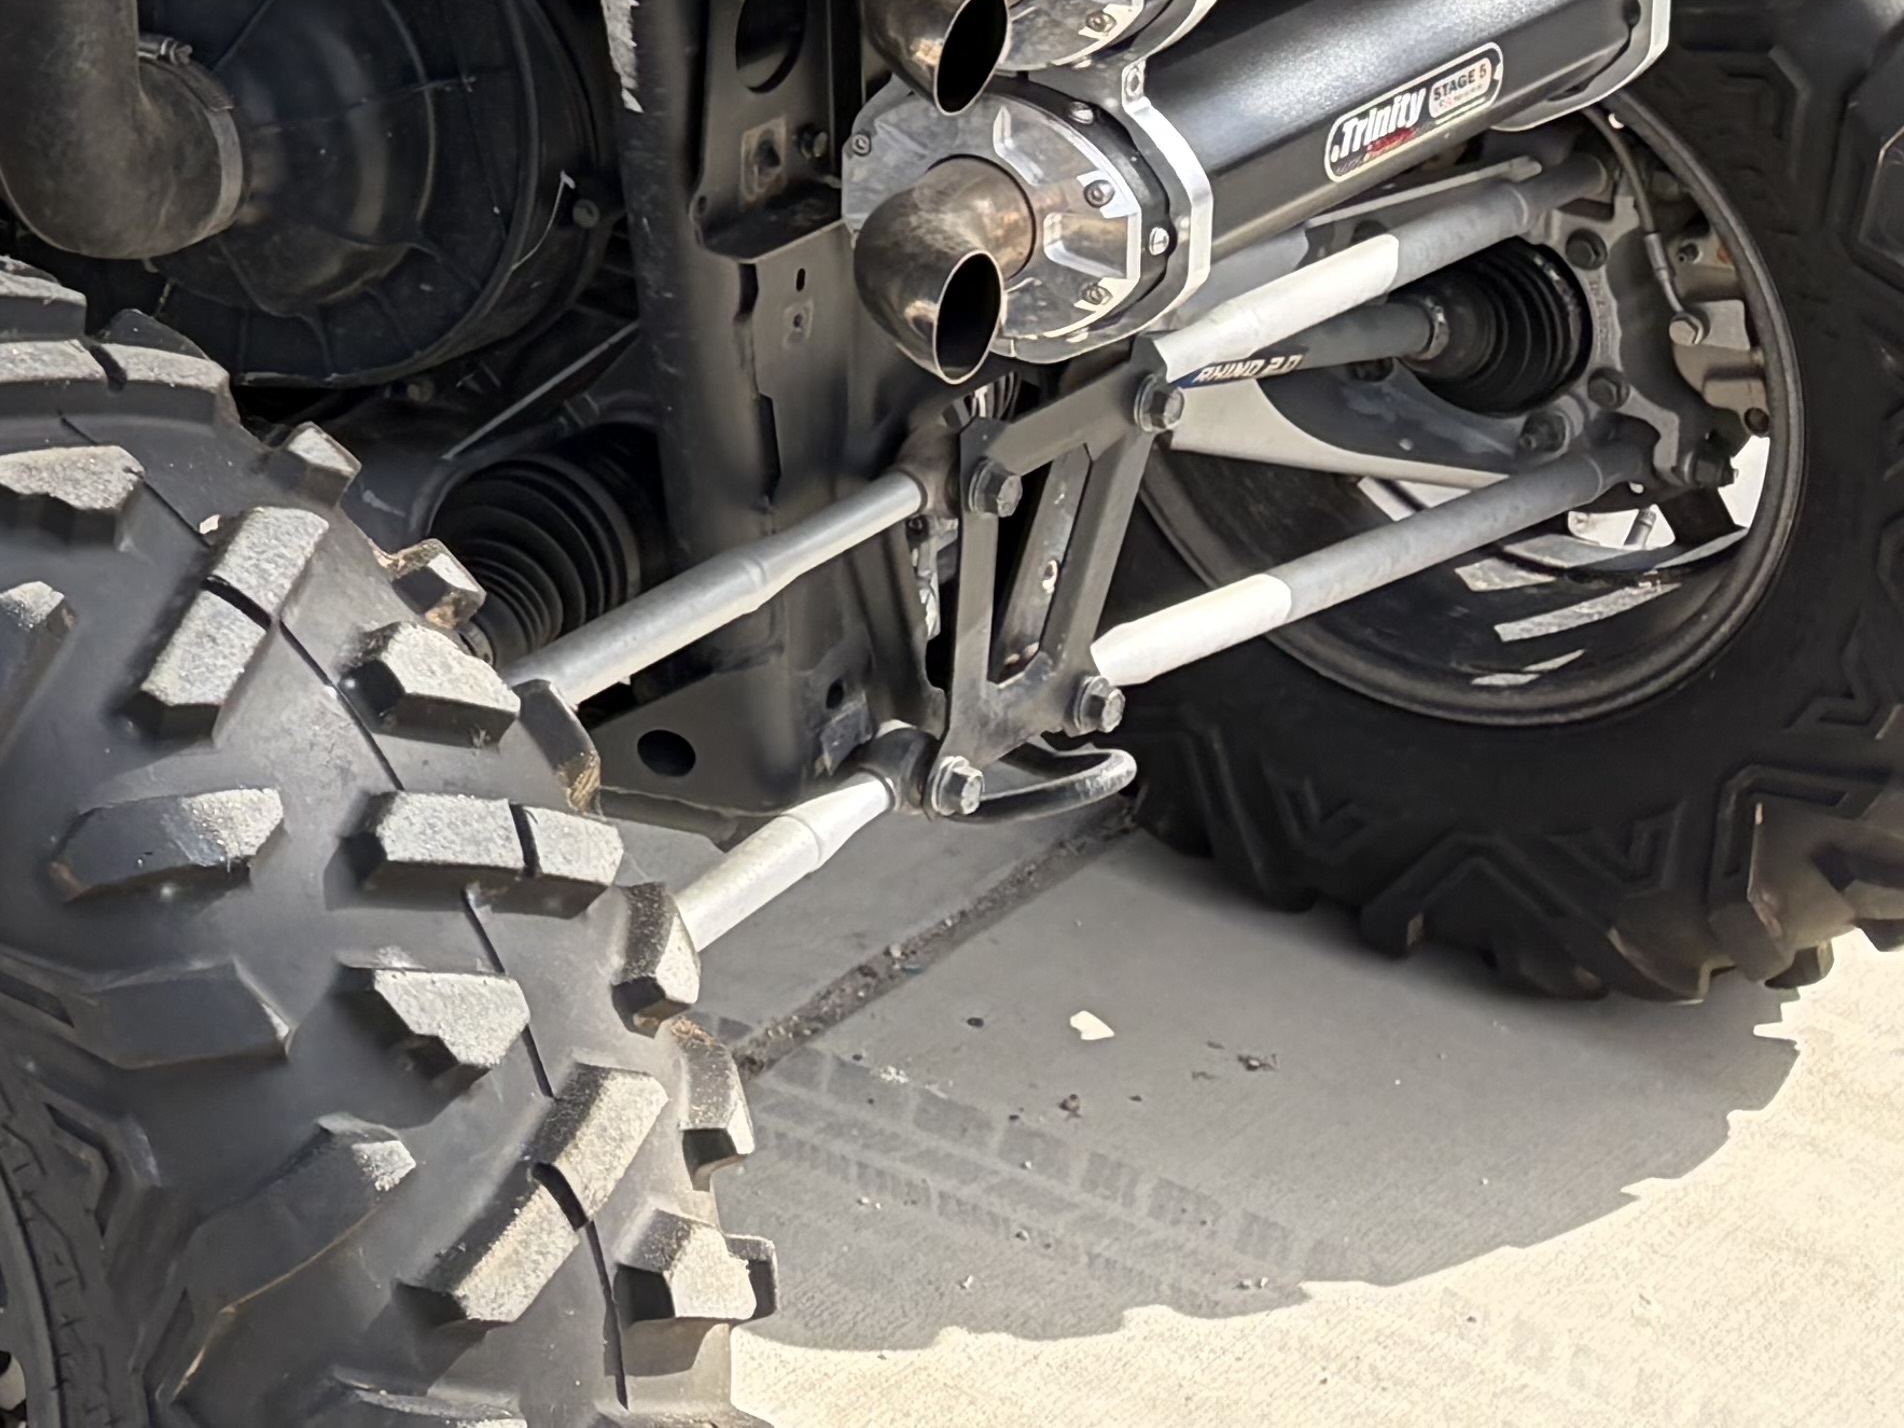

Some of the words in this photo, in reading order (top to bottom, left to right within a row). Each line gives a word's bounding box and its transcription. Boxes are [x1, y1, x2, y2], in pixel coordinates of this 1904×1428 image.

[1433, 68, 1476, 102] STAGE
[1339, 87, 1427, 159] Trinity
[1191, 358, 1267, 383] RHINO
